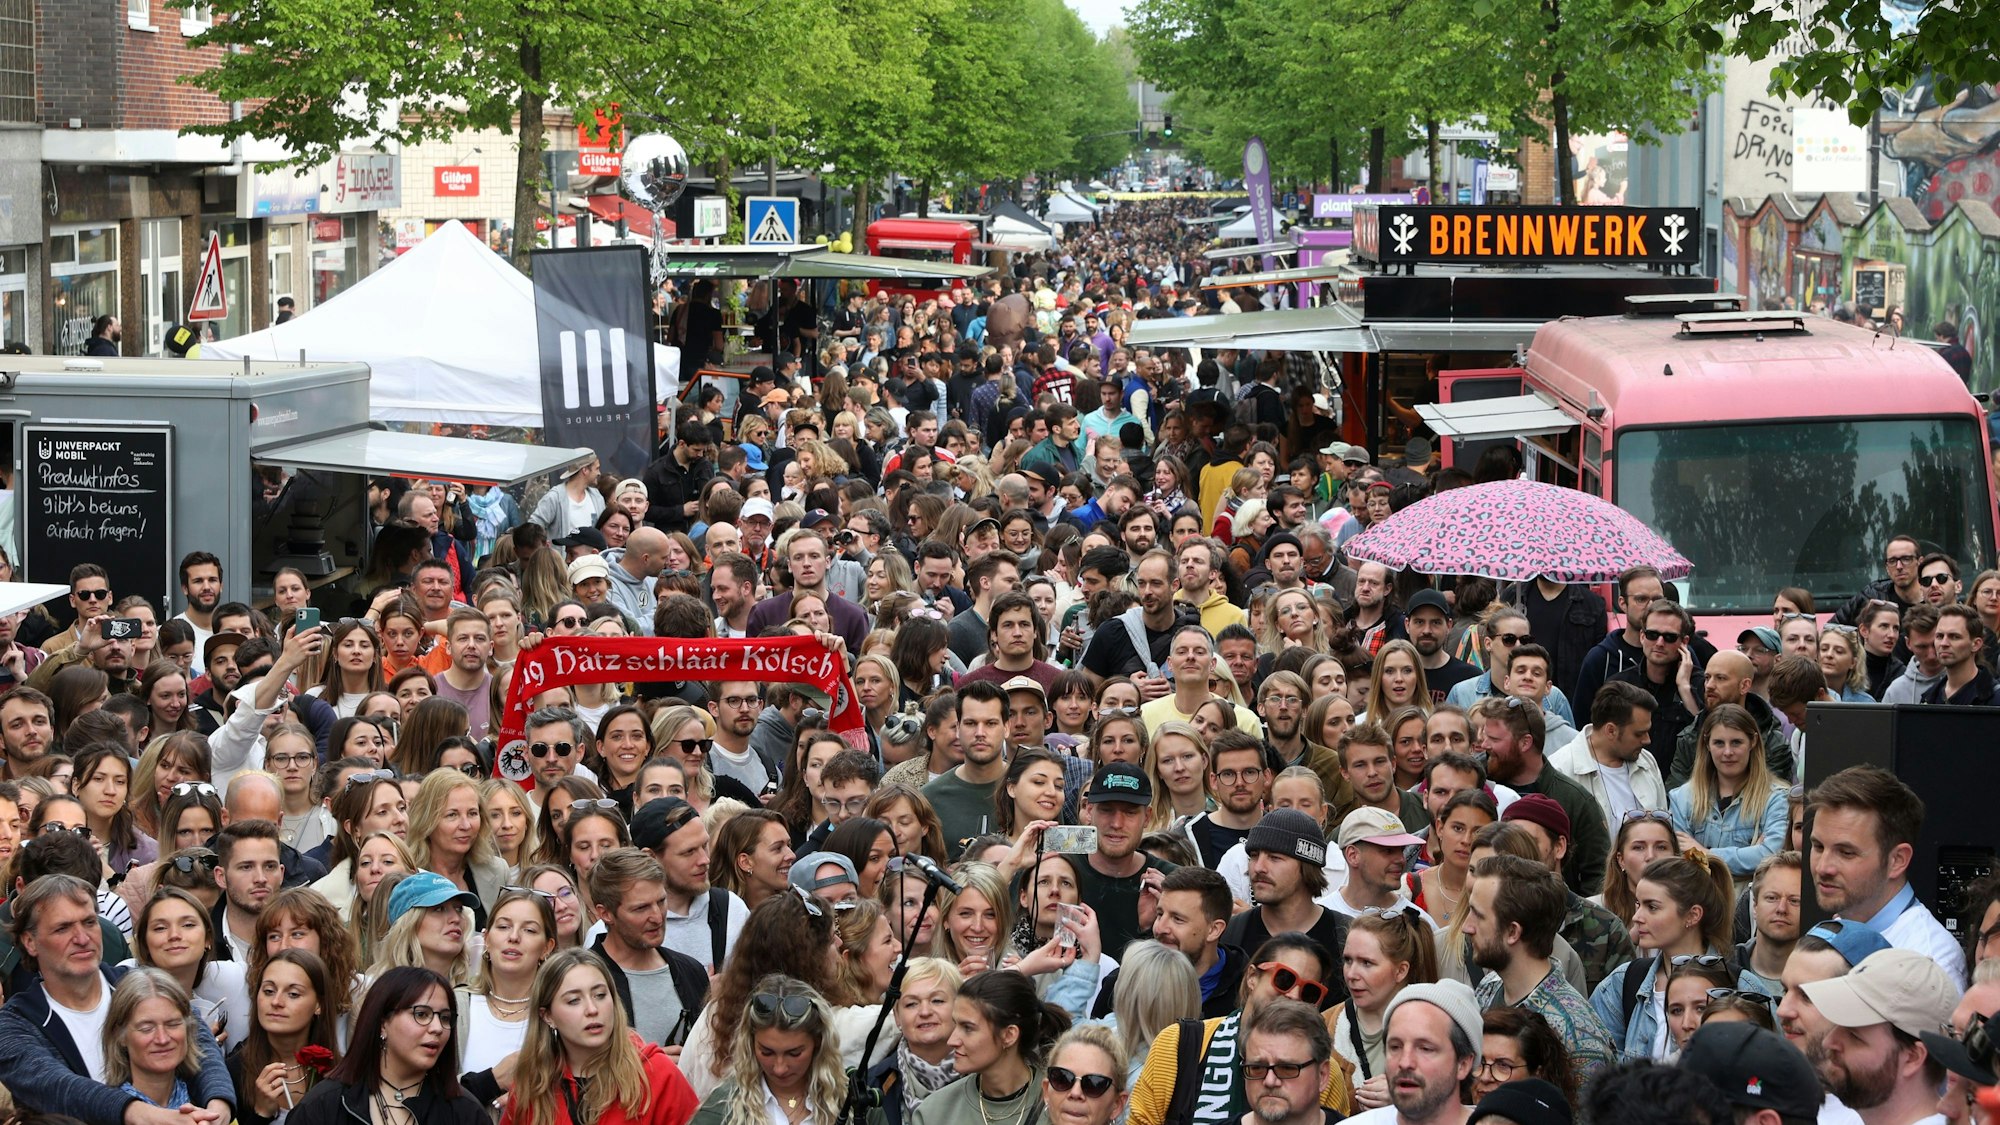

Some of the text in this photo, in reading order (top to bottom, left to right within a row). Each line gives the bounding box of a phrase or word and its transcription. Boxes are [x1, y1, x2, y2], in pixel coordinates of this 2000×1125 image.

[581, 154, 619, 167] Gilden
[441, 170, 472, 184] Gilden
[1430, 214, 1648, 256] BRENNWERK
[55, 441, 122, 451] UNVERPACKT
[55, 451, 87, 461] MOBIL
[38, 462, 140, 488] Produktinfos
[43, 494, 86, 514] gibt's
[46, 518, 147, 542] einfach fragen!
[551, 646, 834, 679] Hätz schläät Kölsch
